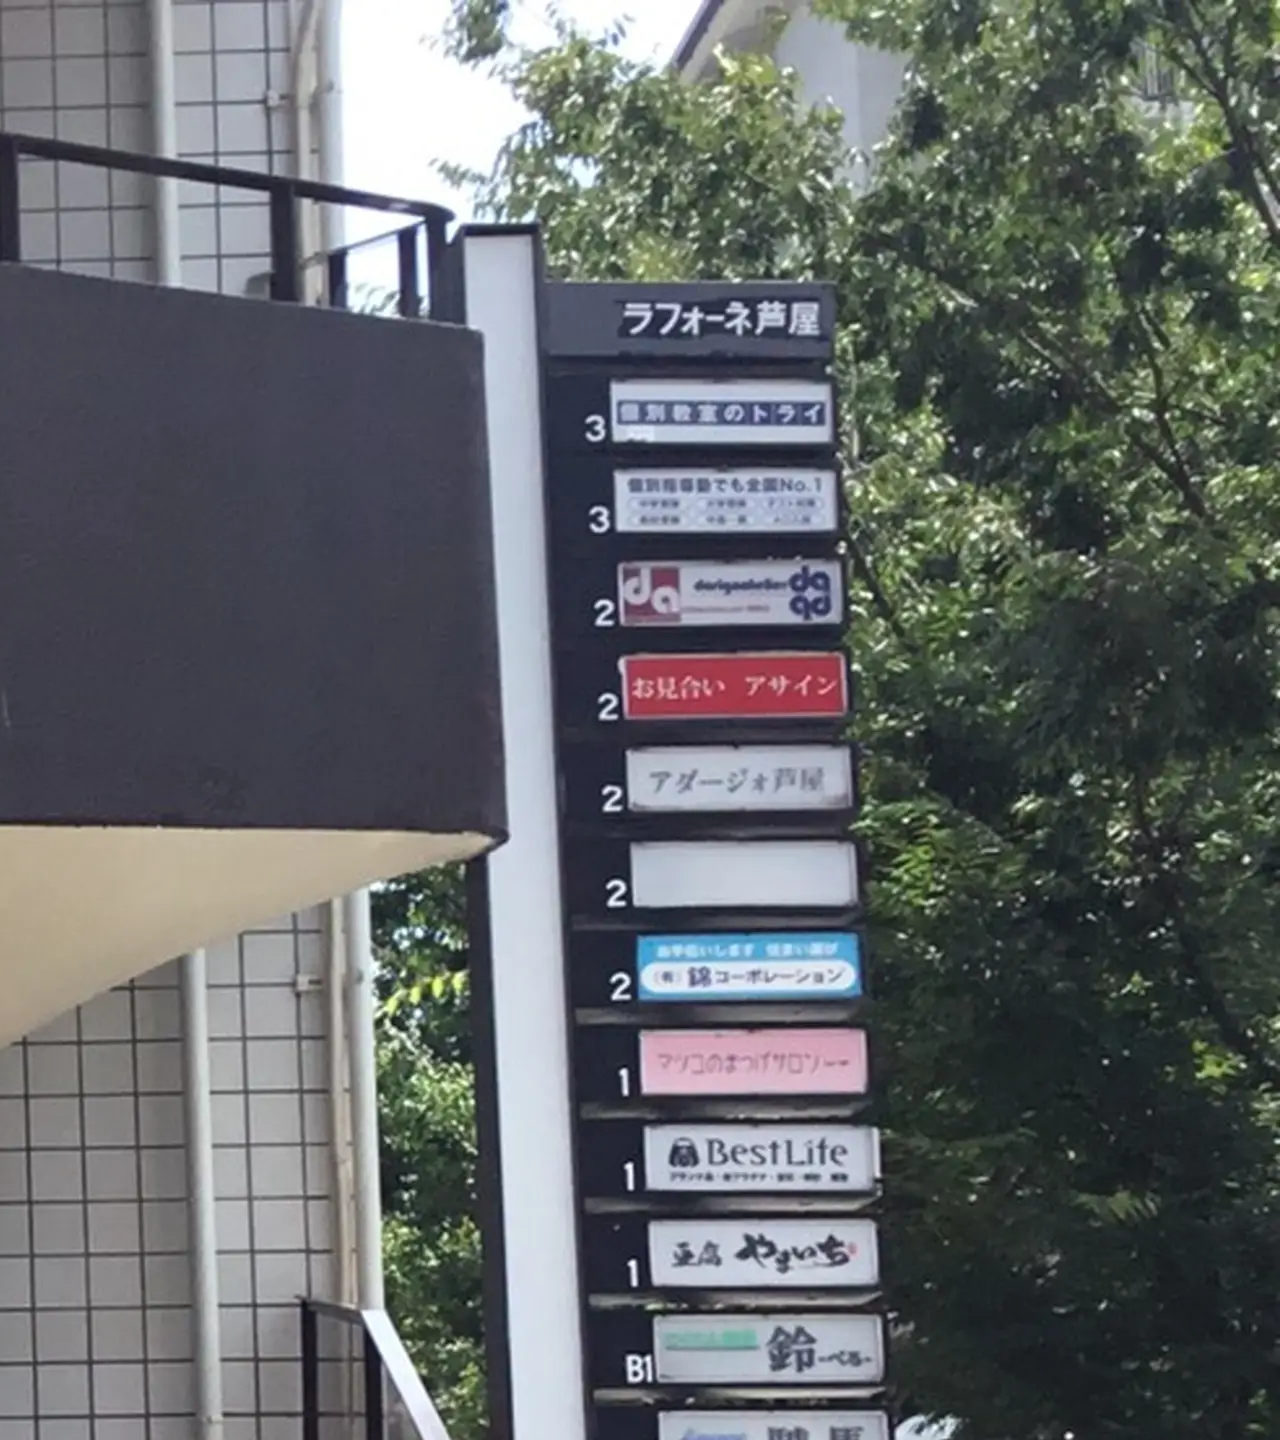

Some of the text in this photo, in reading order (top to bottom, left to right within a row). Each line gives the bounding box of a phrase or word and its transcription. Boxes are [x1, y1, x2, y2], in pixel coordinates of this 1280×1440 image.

[623, 301, 821, 336] ラフォーネ芦屋
[585, 416, 606, 441] 3
[589, 507, 610, 532] 3
[594, 600, 615, 626] 2
[631, 675, 838, 699] お見合い アサイン
[597, 693, 619, 720] 2
[602, 785, 623, 812] 2
[606, 880, 627, 907] 2
[609, 972, 632, 1000] 2
[619, 1067, 630, 1097] 1
[706, 1137, 849, 1167] BestLife
[624, 1162, 635, 1191] 1
[734, 1233, 852, 1274] やまいち
[627, 1259, 639, 1288] 1
[766, 1326, 818, 1373] 鈴
[626, 1355, 654, 1383] B1
